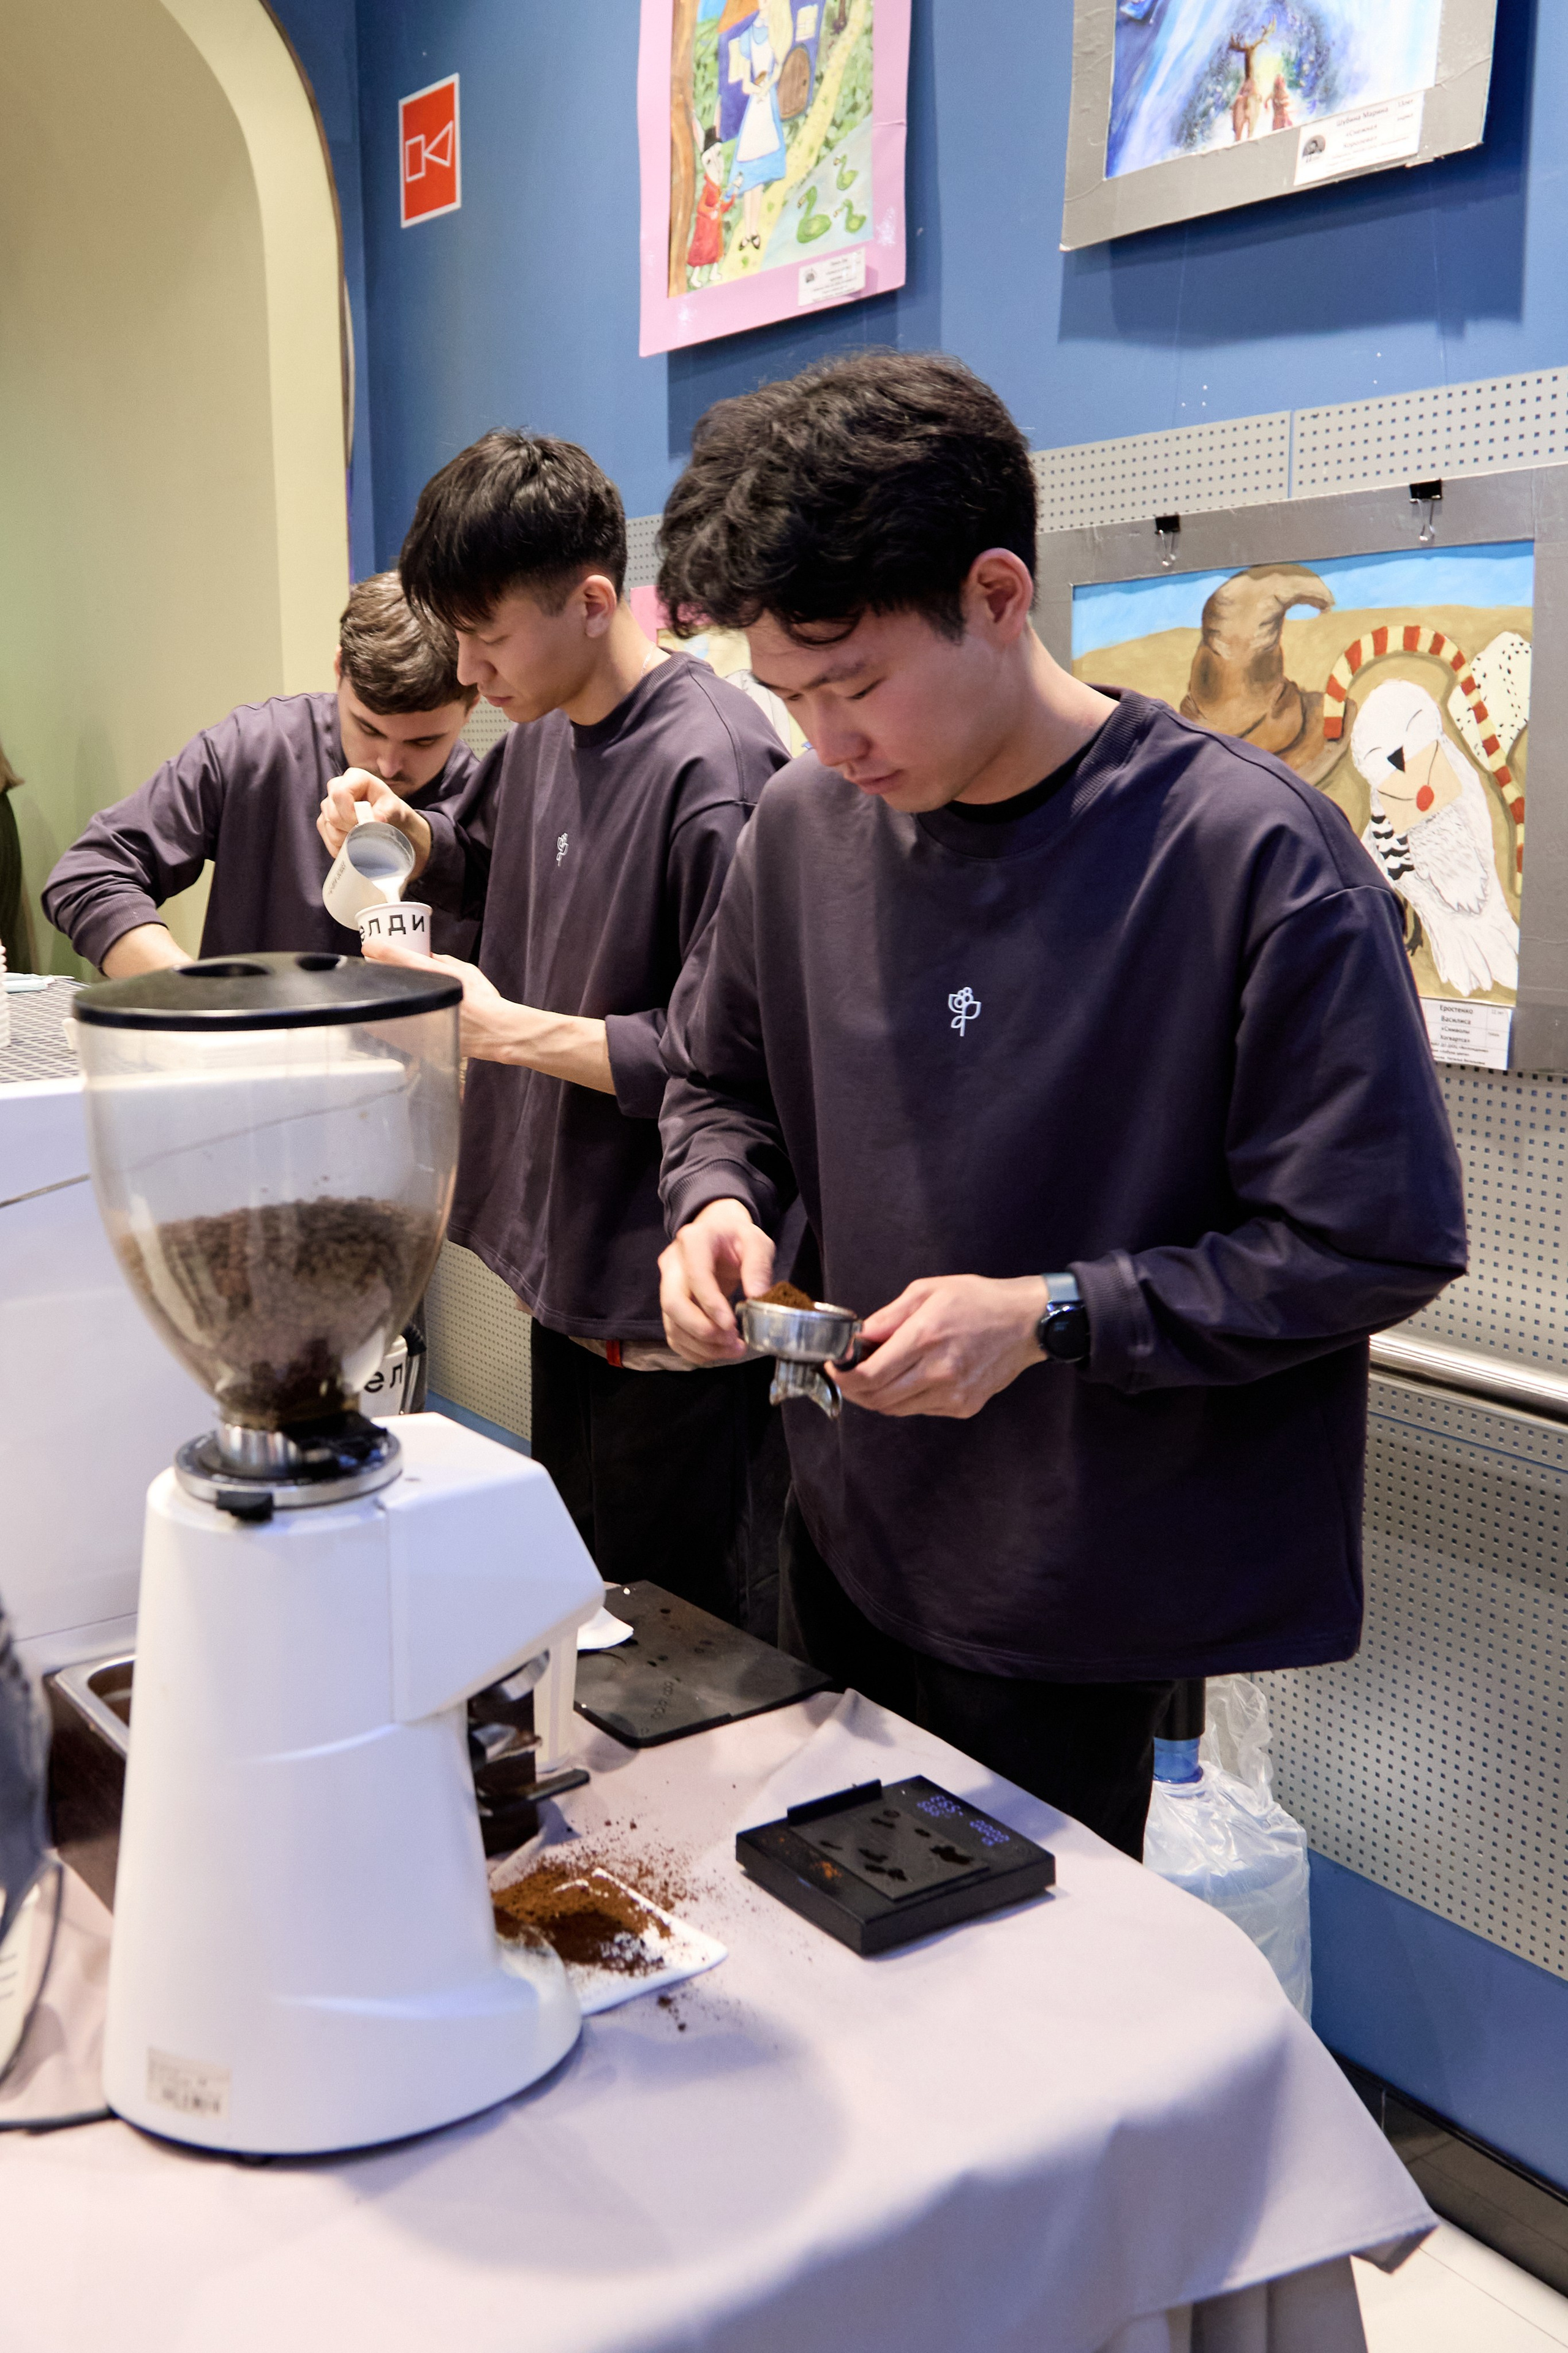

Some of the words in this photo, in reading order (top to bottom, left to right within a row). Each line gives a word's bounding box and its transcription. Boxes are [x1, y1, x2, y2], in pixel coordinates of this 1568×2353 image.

[1336, 115, 1361, 126] Шубина
[1363, 107, 1389, 118] Марина
[1439, 1005, 1473, 1014] Еростенко
[1441, 1015, 1471, 1024] Василиса
